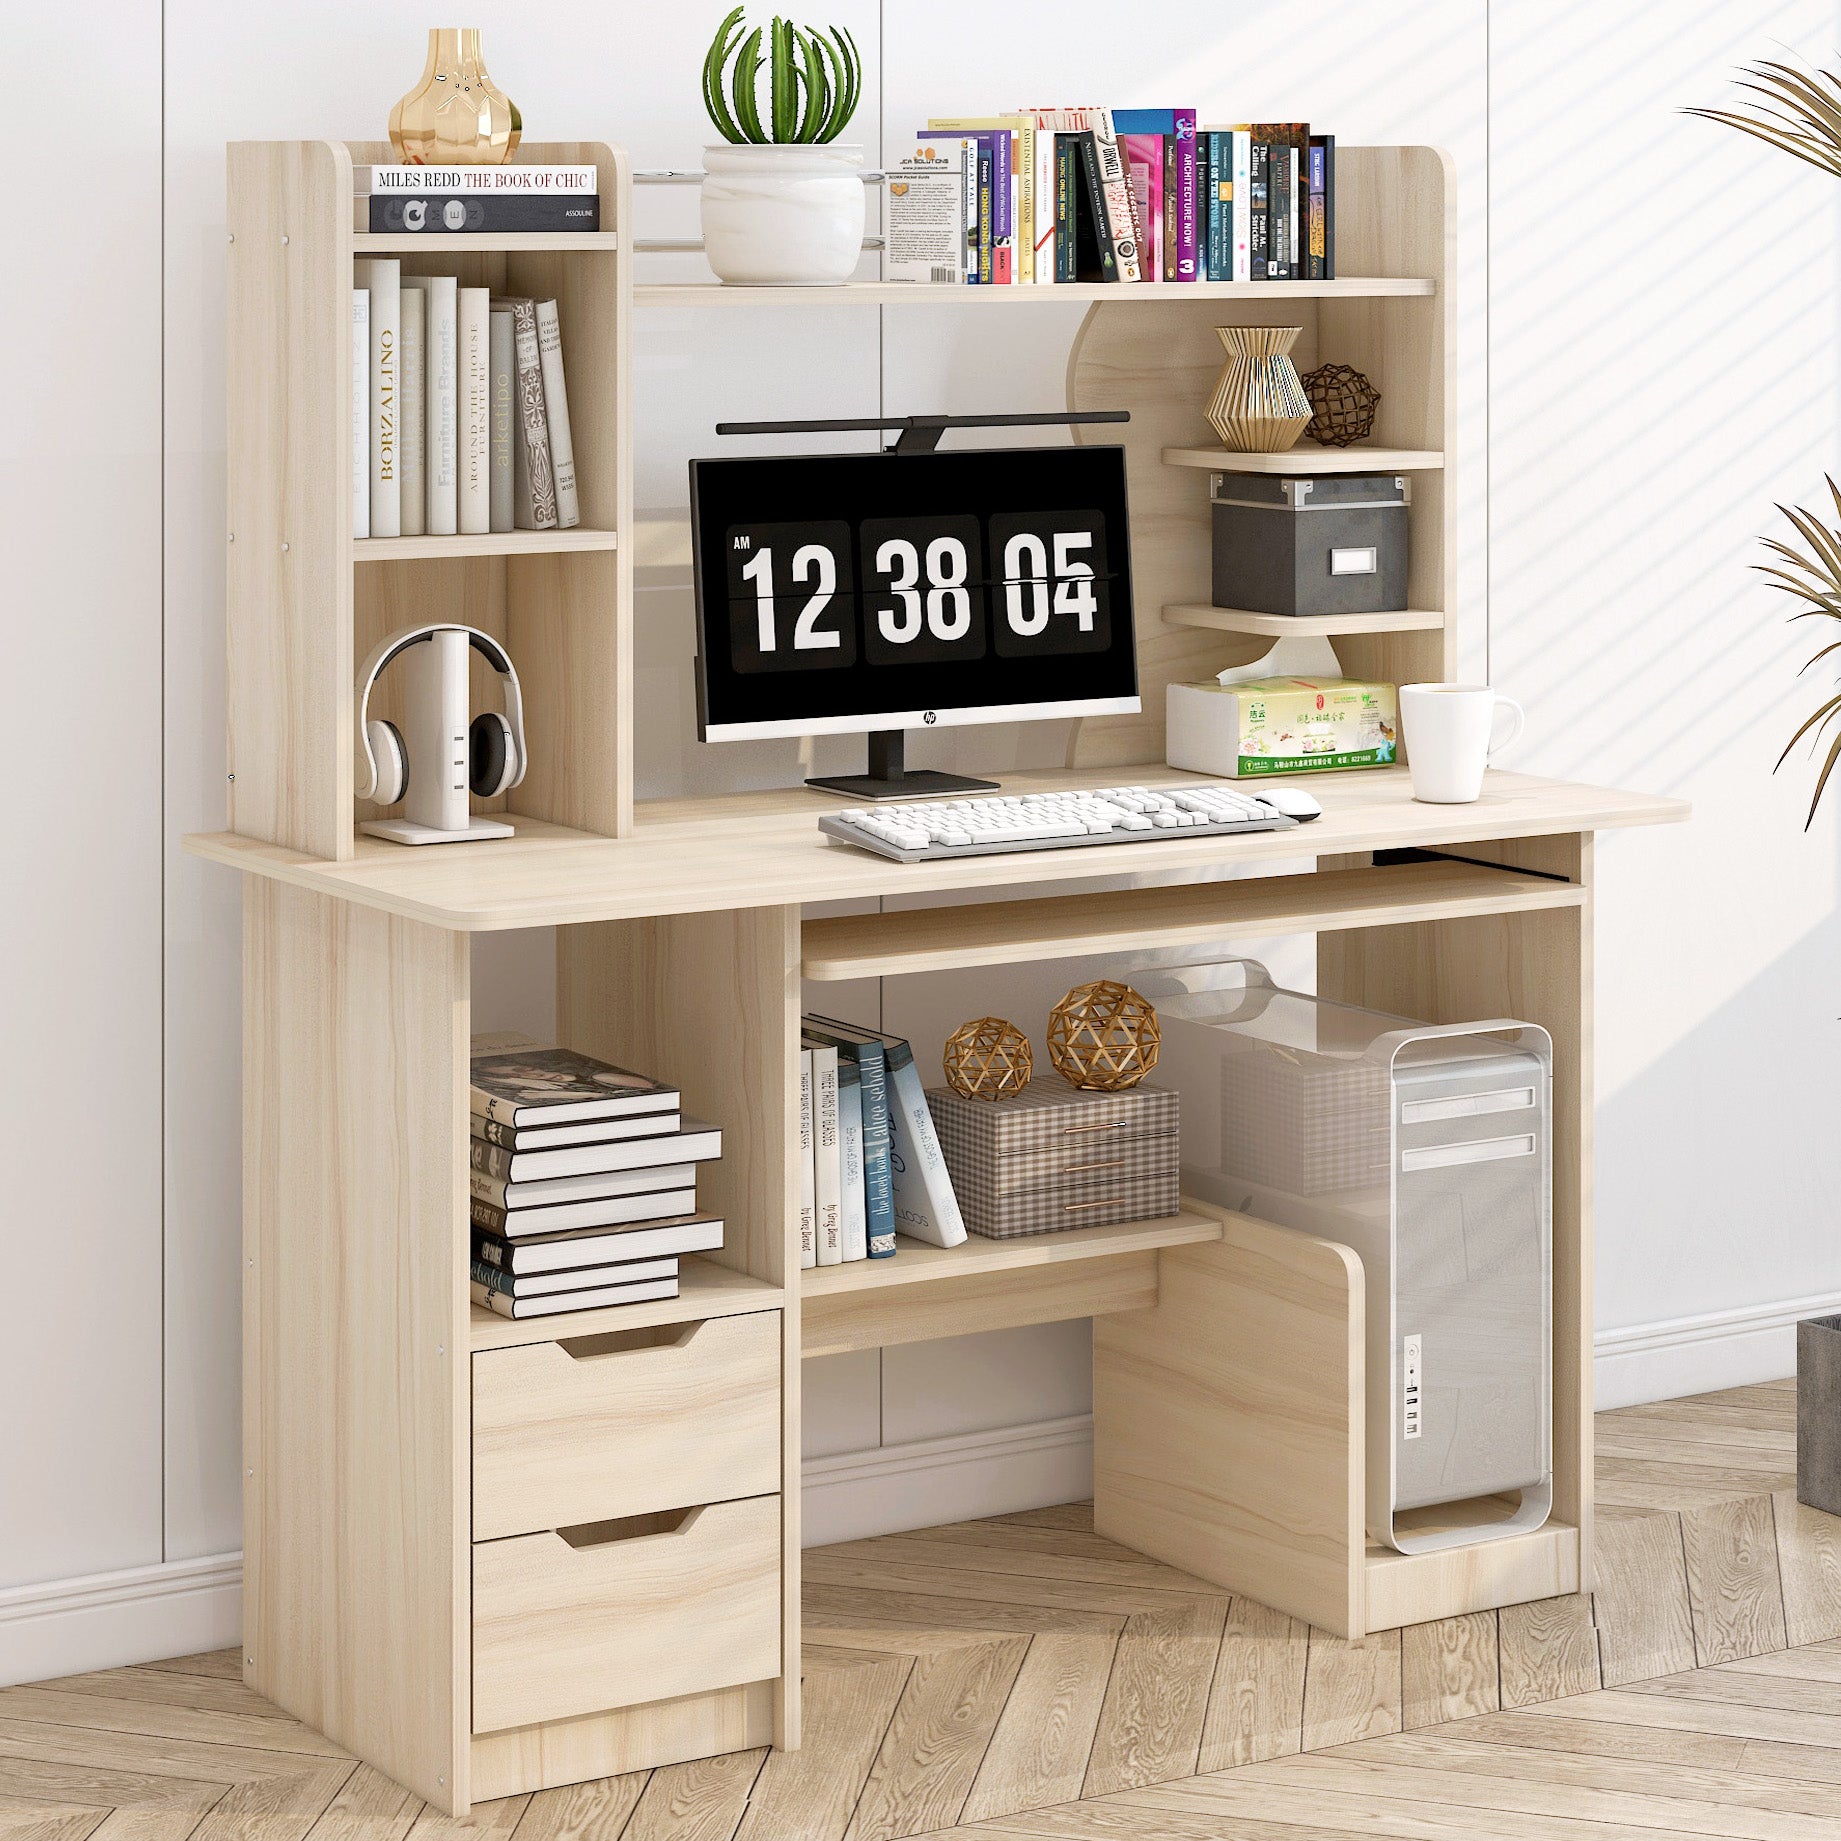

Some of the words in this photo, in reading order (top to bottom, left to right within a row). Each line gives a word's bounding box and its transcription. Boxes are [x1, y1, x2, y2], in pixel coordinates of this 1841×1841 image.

[1102, 147, 1120, 177] ORWELL
[1251, 146, 1260, 177] Calling
[1260, 145, 1268, 163] The
[379, 172, 421, 188] MILES
[424, 172, 461, 188] REDD
[464, 173, 492, 188] THE
[495, 173, 532, 188] BOOK
[534, 173, 552, 188] OF
[555, 173, 588, 188] CHIC
[981, 160, 989, 183] Reese
[1210, 167, 1219, 179] ON
[1183, 153, 1193, 221] ARCHITECTURE
[1210, 180, 1219, 198] THE
[1237, 183, 1247, 210] Love
[565, 209, 594, 218] ASSOULINE
[981, 187, 989, 215] HONG
[1210, 199, 1219, 229] STORM
[981, 217, 989, 244] KONG
[1183, 222, 1193, 248] NOW!
[1259, 214, 1267, 234] Paul
[1259, 236, 1267, 248] M.
[981, 246, 989, 282] NIGHTS
[437, 318, 451, 390] Brands
[470, 323, 478, 377] HOUSE
[380, 329, 394, 481] BORZALINO
[470, 385, 478, 418] THE
[493, 374, 511, 467] arketipo
[437, 395, 451, 487] Furniture
[470, 424, 478, 492] AROUND
[733, 536, 750, 550] AM
[742, 544, 841, 652] 12
[876, 536, 972, 644] 38
[924, 711, 937, 725] hp
[821, 1070, 834, 1090] THREE
[859, 1055, 886, 1101] sebold
[821, 1090, 834, 1108] PAIRS
[822, 1109, 835, 1117] OF
[863, 1105, 888, 1137] alice
[821, 1119, 836, 1147] GLASSES
[869, 1176, 891, 1201] lovely
[822, 1204, 837, 1212] by
[822, 1212, 837, 1228] Greg
[872, 1200, 890, 1215] the
[801, 1231, 812, 1252] Bennet
[827, 1228, 838, 1248] Bennet
[471, 1262, 502, 1291] ebold
